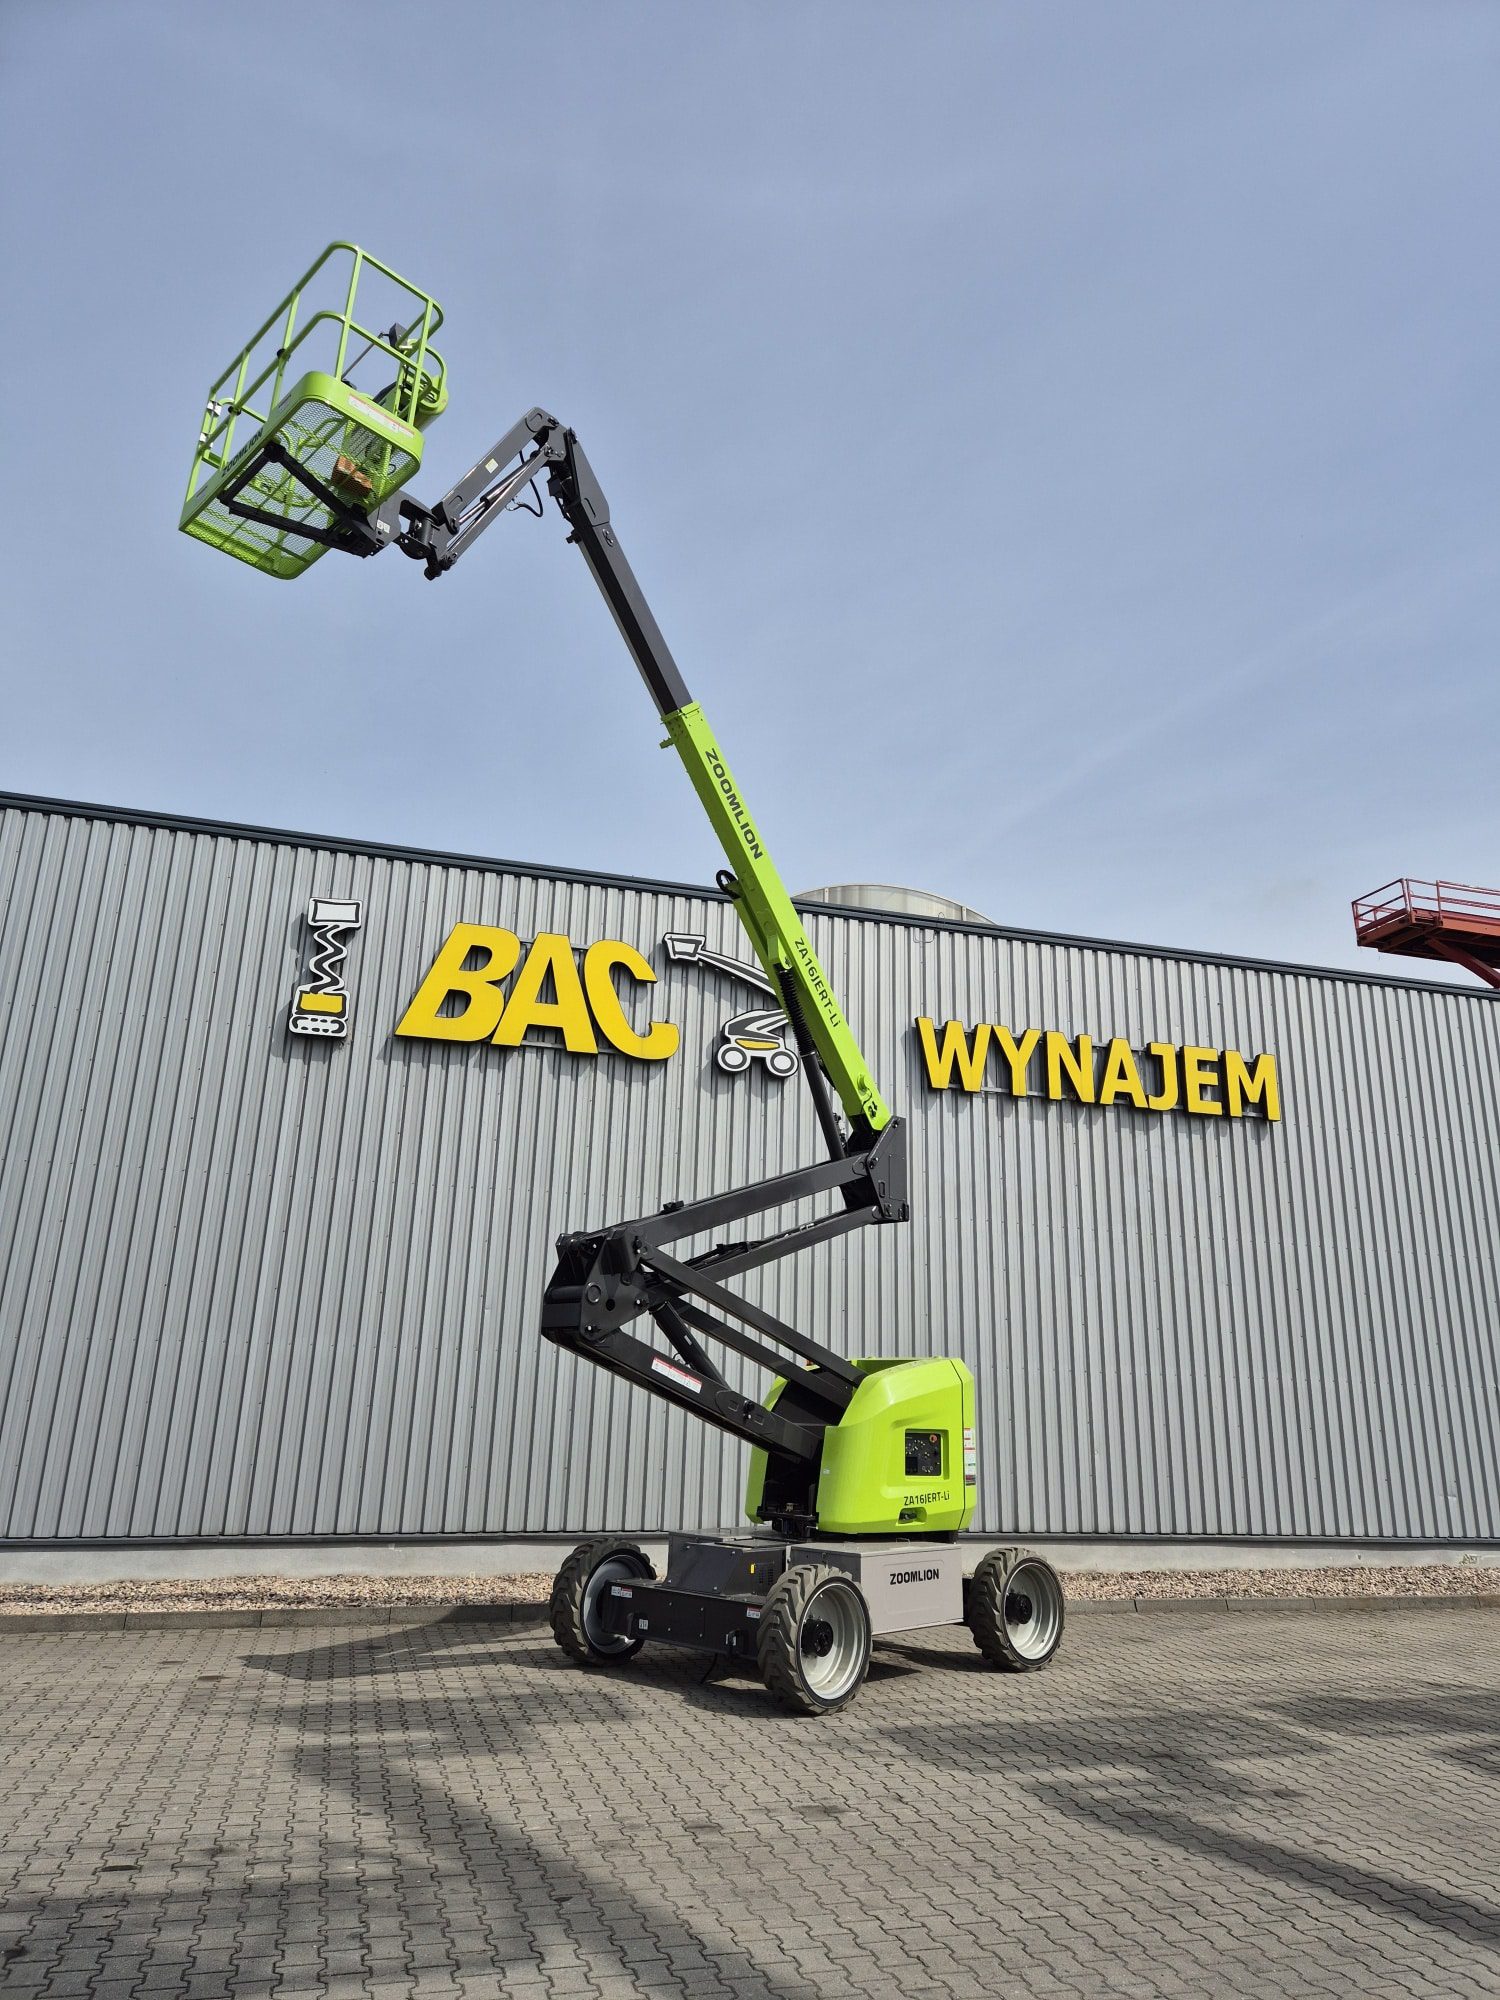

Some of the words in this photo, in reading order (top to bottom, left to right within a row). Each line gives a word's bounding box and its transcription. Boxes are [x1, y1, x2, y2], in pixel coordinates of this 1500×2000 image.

[704, 747, 764, 860] ZOOMLION
[394, 921, 681, 1061] BAC
[793, 936, 841, 1028] ZA16JERT-Li
[915, 1016, 1281, 1121] WYNAJEM
[903, 1490, 950, 1506] ZA16JERT-Li
[889, 1568, 940, 1586] ZOOMLION
